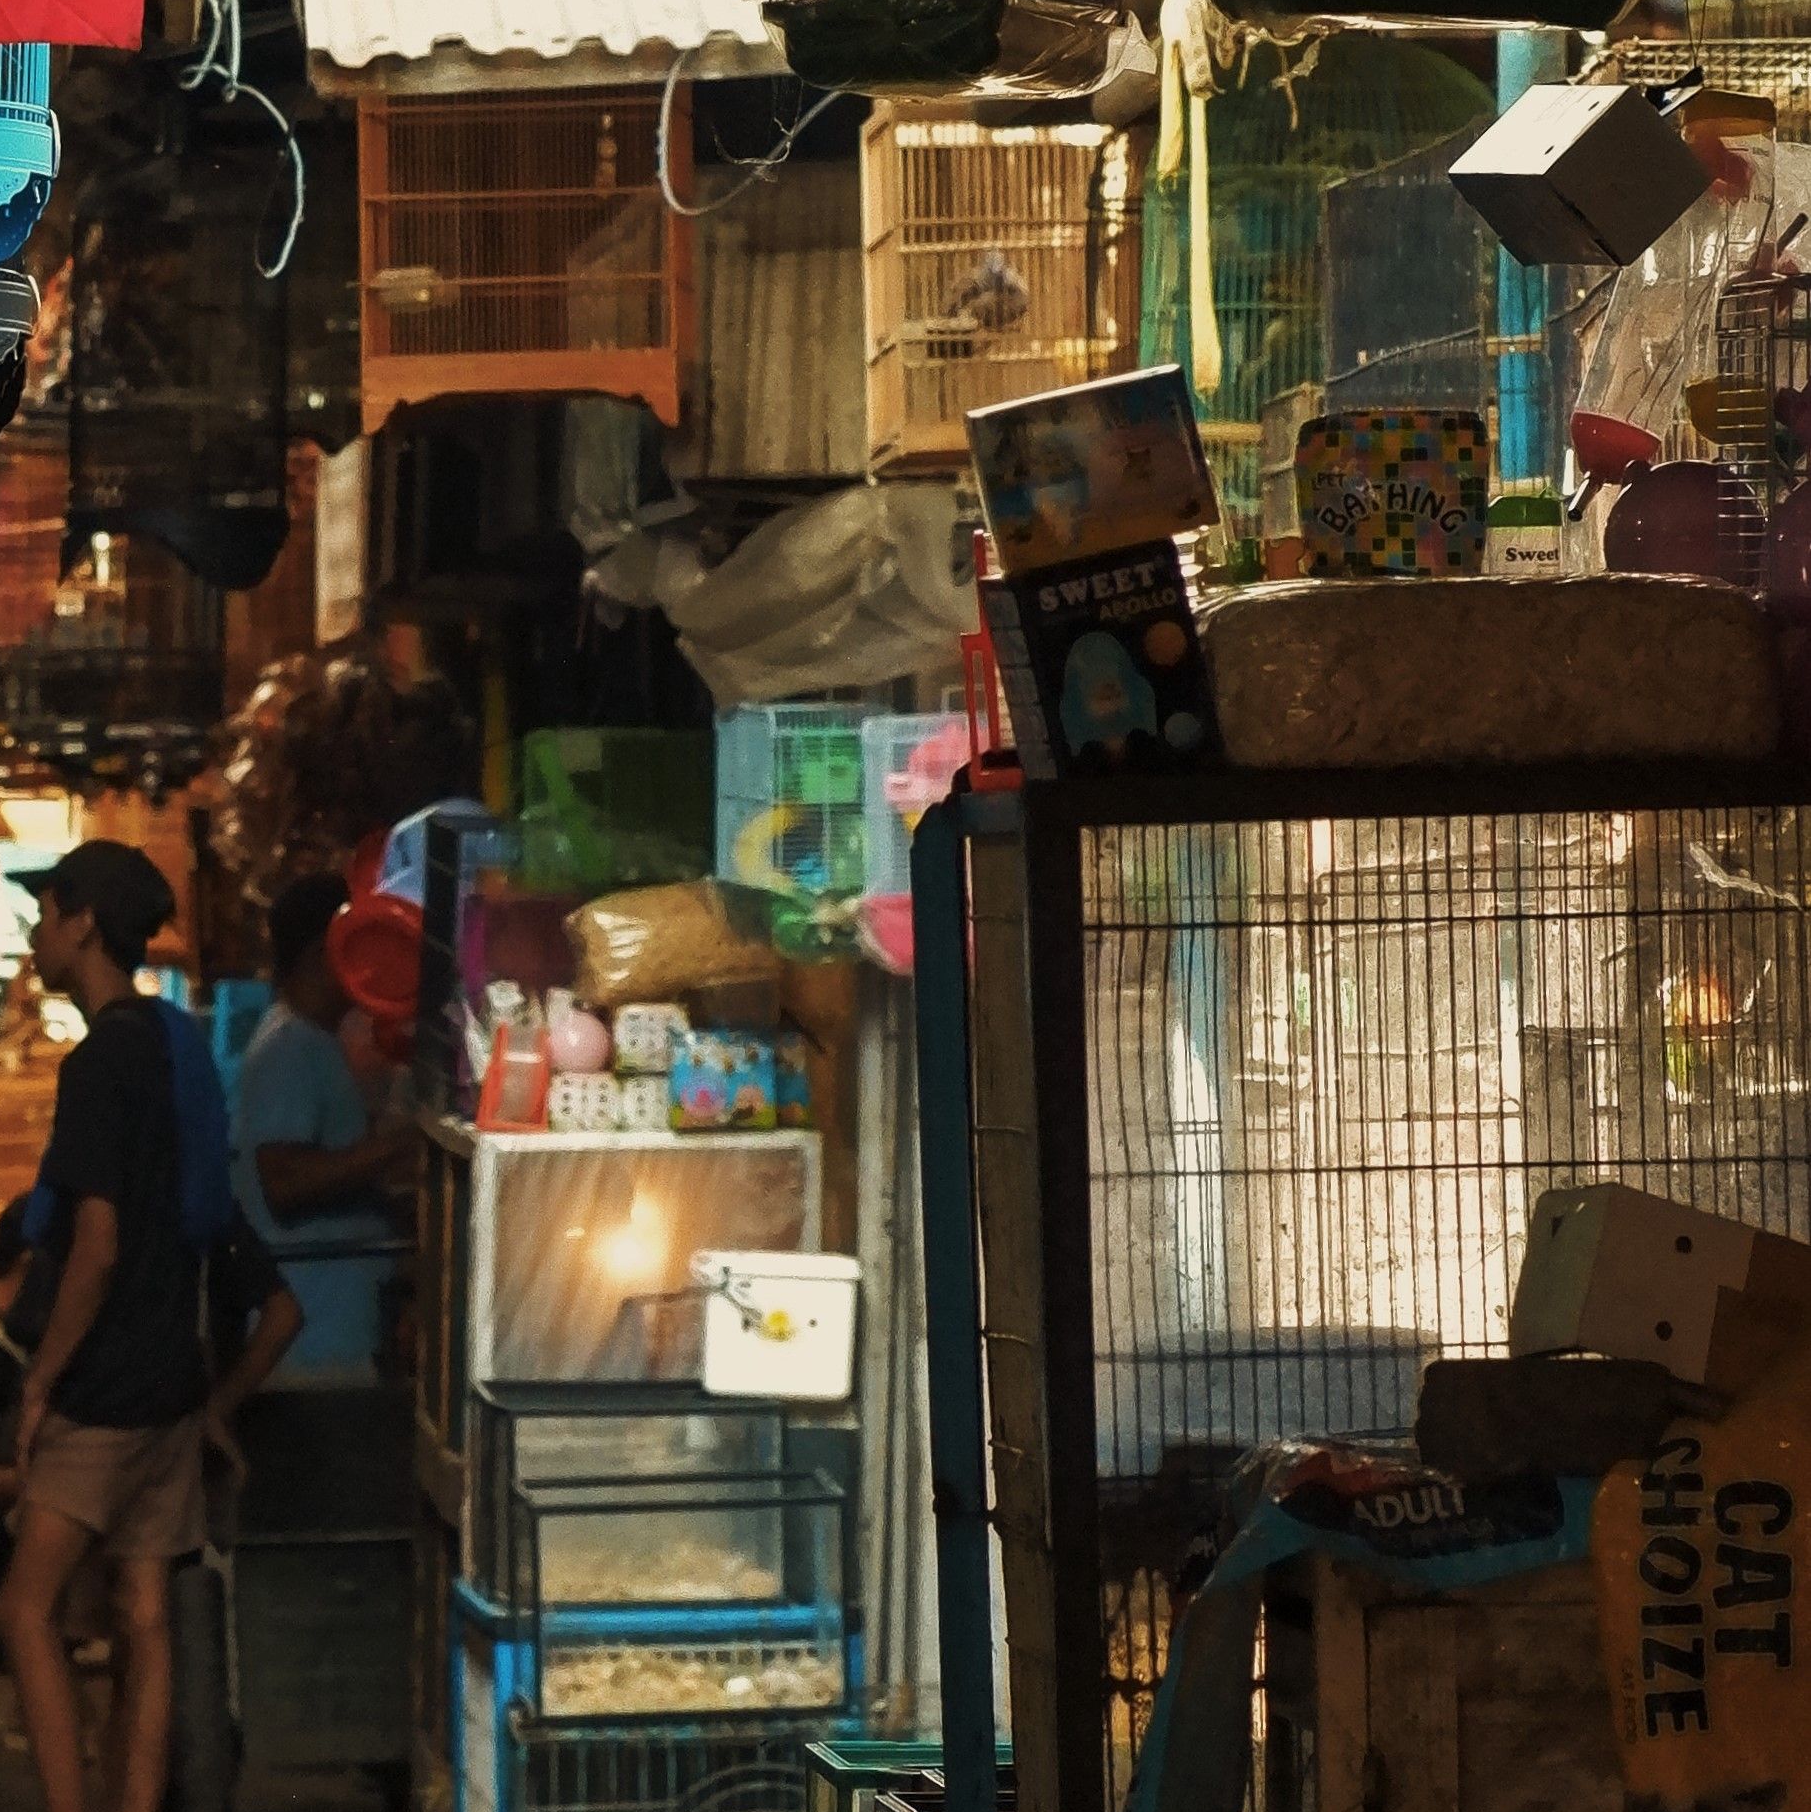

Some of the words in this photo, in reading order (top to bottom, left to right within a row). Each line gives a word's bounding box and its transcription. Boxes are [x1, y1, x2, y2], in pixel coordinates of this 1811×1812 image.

[1038, 562, 1158, 612] SWEET
[1504, 547, 1560, 563] Sweet
[1639, 1437, 1709, 1737] CHOIZE
[1712, 1480, 1793, 1668] CAT
